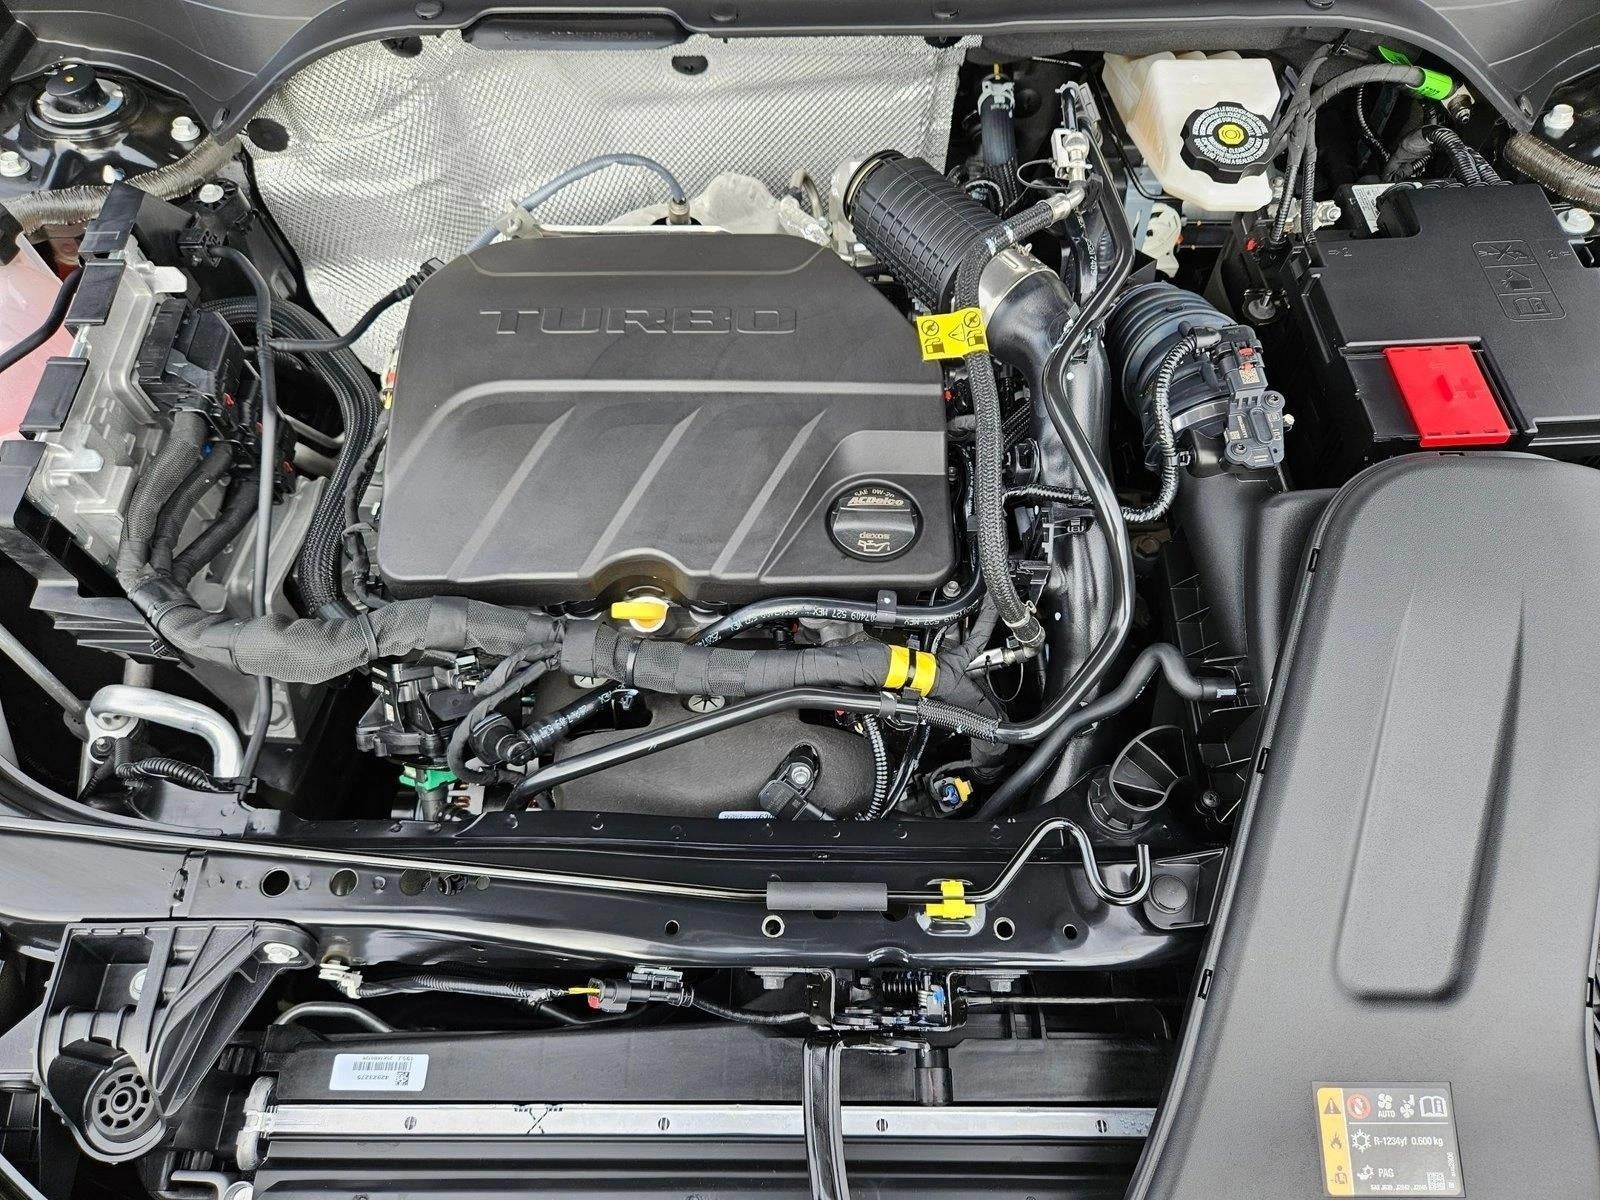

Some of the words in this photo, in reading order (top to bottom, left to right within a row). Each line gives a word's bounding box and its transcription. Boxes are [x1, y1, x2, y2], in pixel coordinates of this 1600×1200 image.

[479, 308, 797, 334] TURBO
[847, 496, 904, 507] ACDelco
[859, 531, 891, 540] dexos
[832, 608, 848, 619] 527
[1378, 1110, 1396, 1118] AUTO
[1411, 1136, 1433, 1146] 0.600
[1433, 1136, 1444, 1147] kg
[1378, 1168, 1395, 1178] PAG
